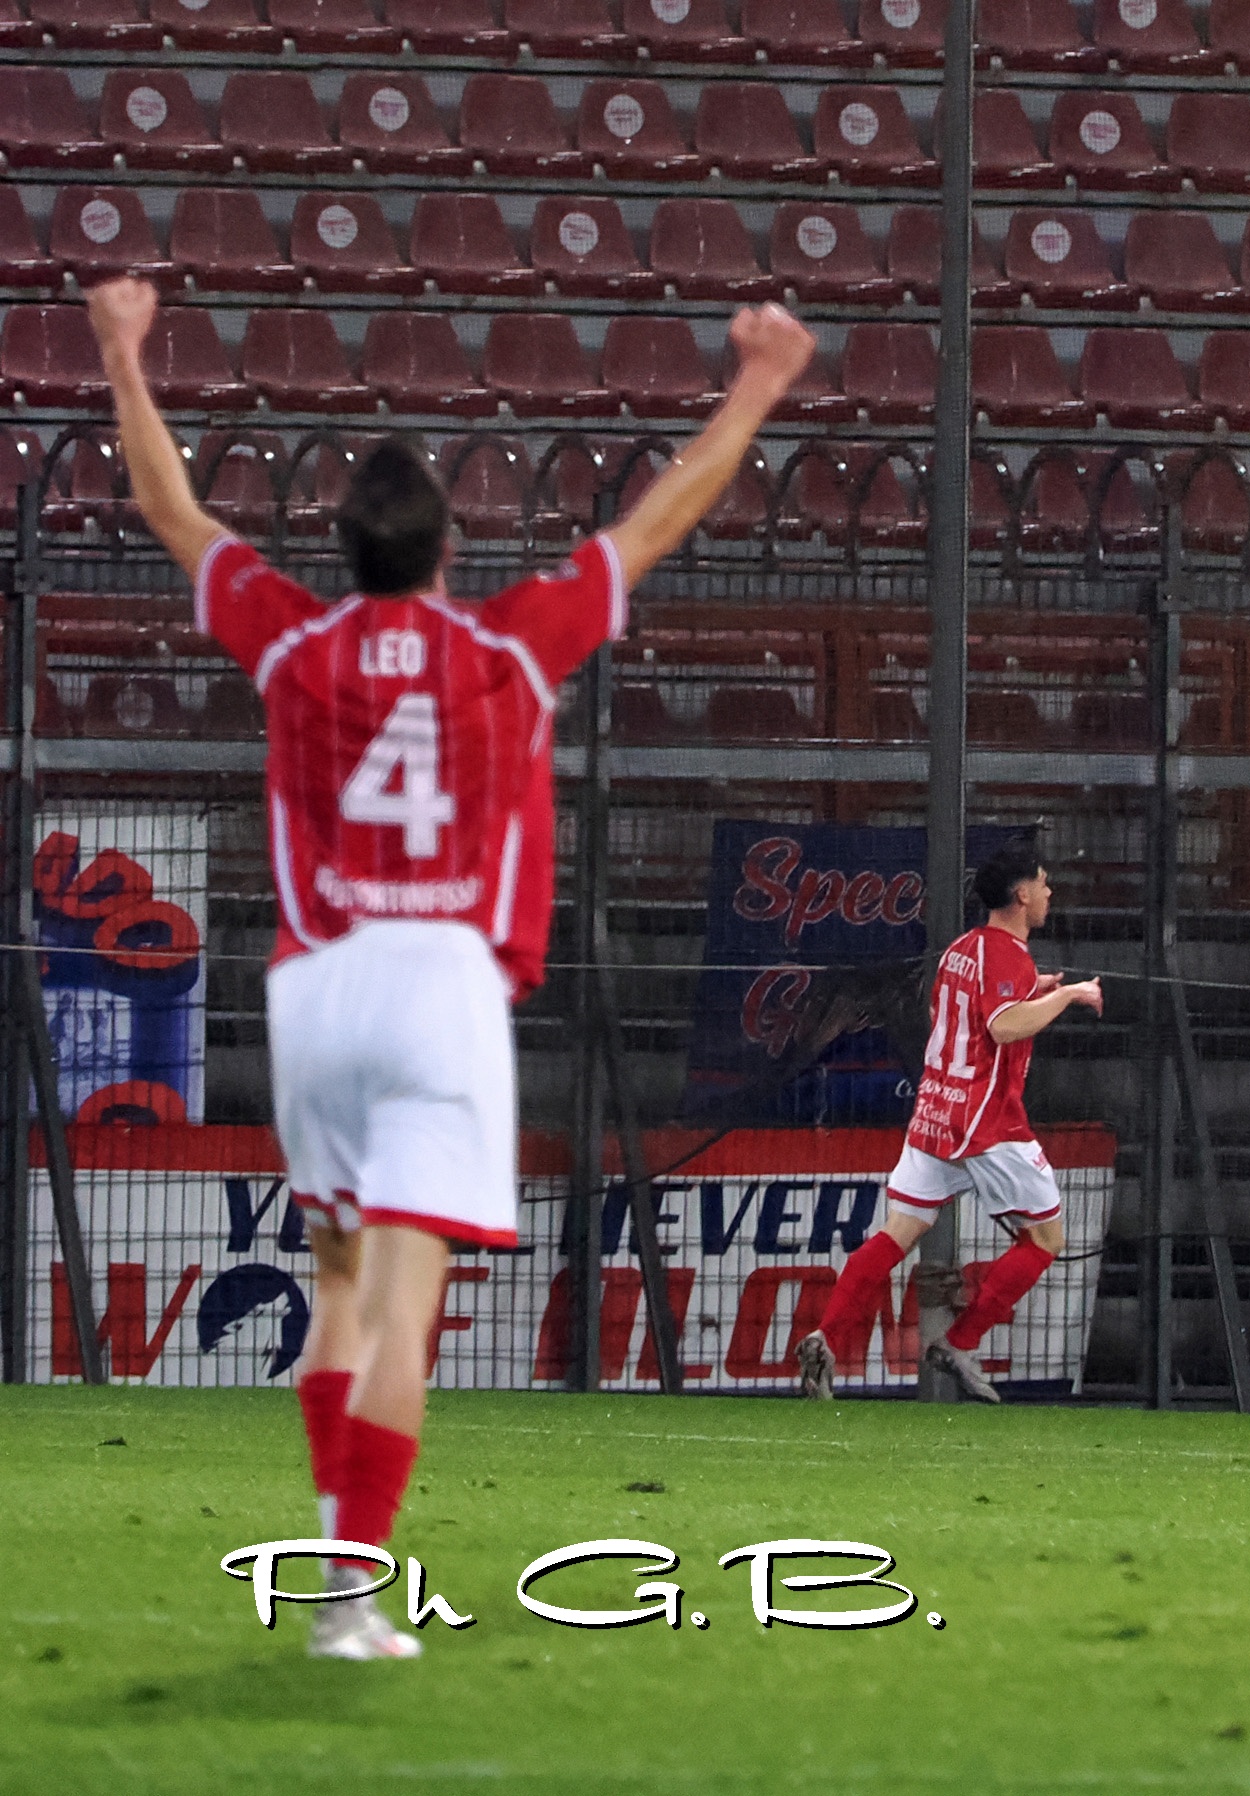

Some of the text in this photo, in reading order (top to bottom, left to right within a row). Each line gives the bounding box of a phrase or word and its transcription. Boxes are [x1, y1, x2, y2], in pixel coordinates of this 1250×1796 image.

[359, 629, 426, 678] LEO
[340, 692, 456, 859] 4
[924, 983, 976, 1081] 11
